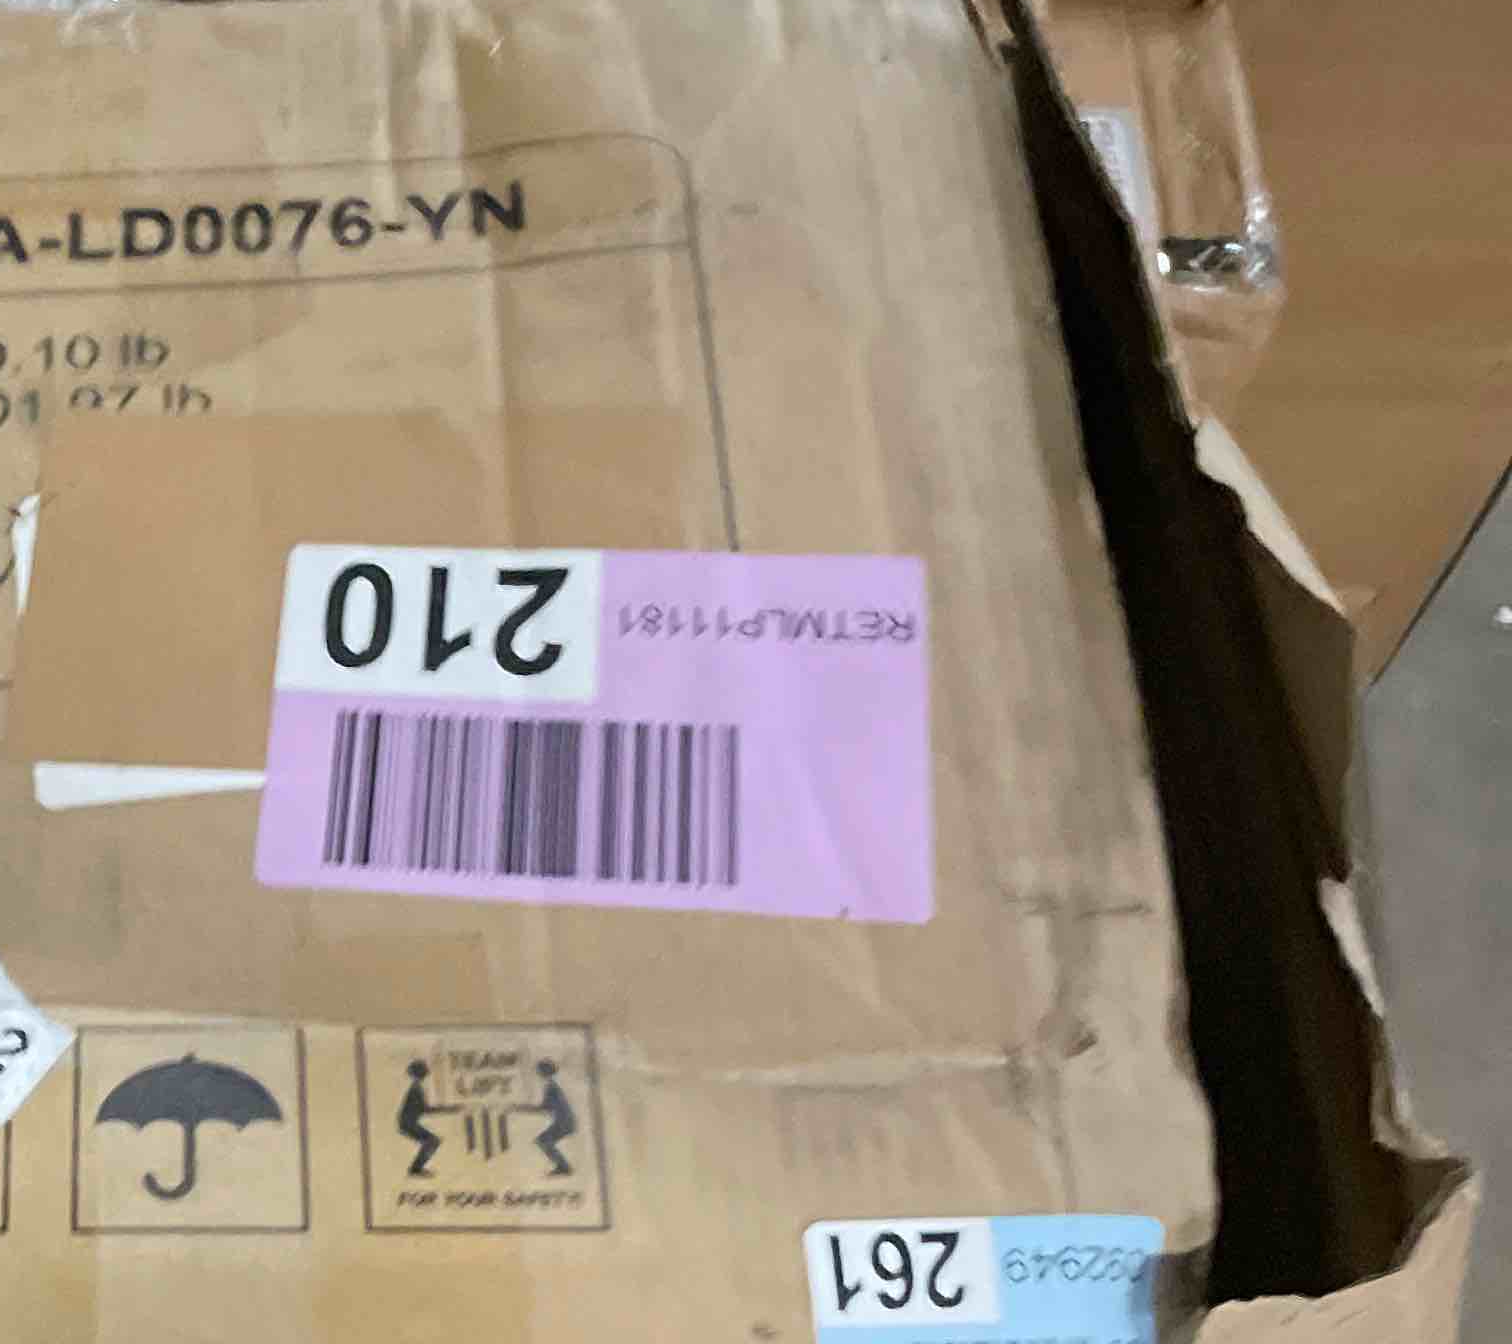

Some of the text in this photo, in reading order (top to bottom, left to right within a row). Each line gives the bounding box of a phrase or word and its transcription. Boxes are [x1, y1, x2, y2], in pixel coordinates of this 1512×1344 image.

[119, 330, 172, 369] lb
[323, 562, 569, 677] 210
[828, 1231, 966, 1312] 261
